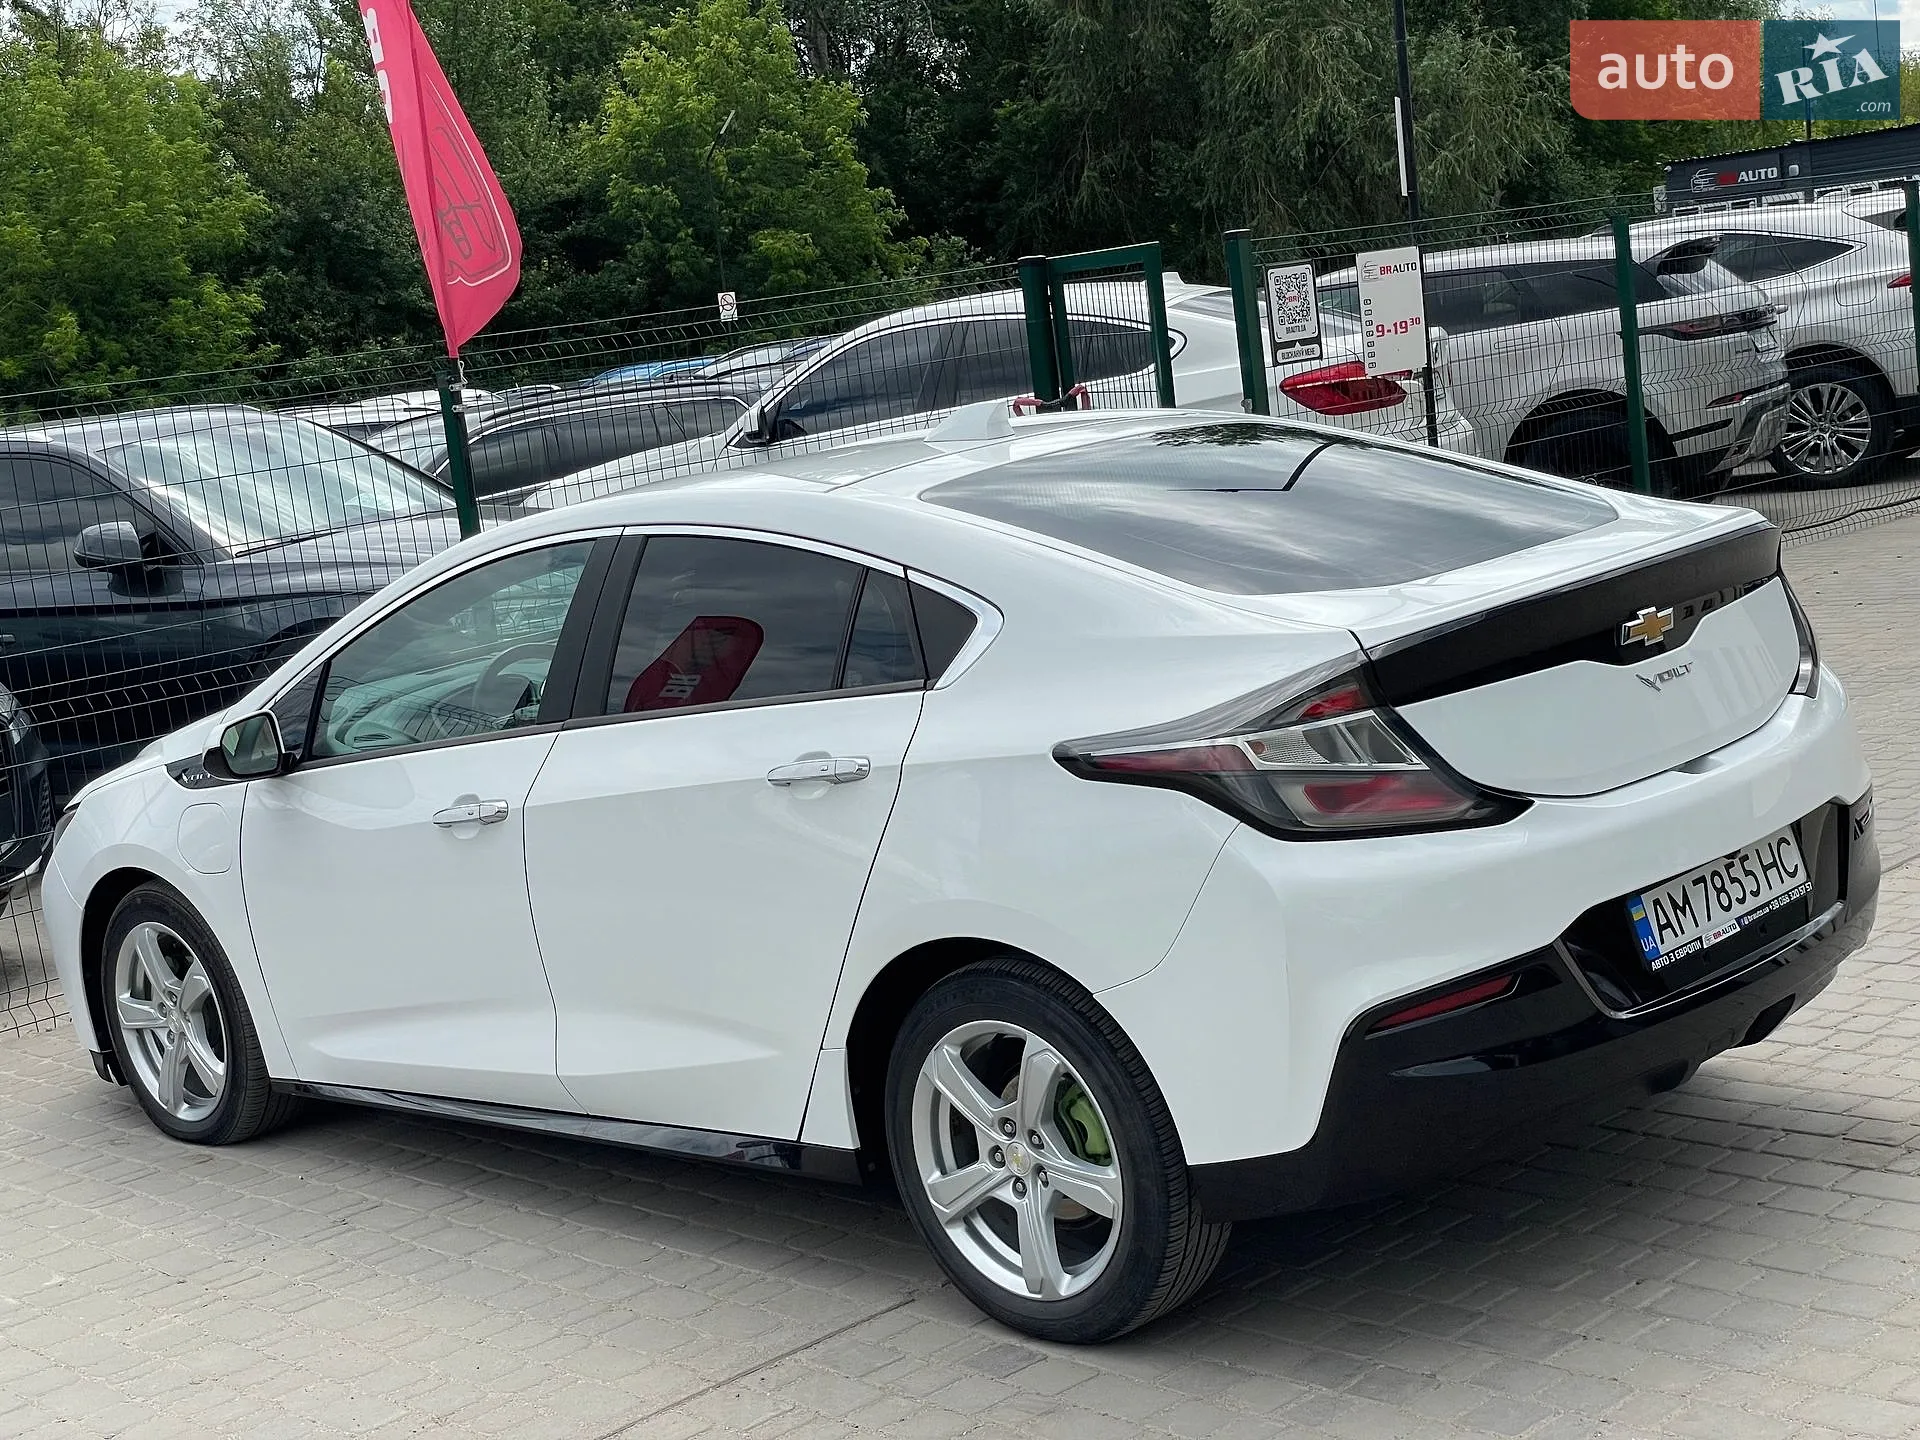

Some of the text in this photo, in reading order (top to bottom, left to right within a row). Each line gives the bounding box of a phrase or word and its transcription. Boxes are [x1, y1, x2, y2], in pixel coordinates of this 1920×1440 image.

[1379, 262, 1417, 276] BRAUTO
[1635, 661, 1693, 692] VOLT
[1712, 922, 1738, 940] BRAUTO
[1641, 934, 1657, 952] UA
[1651, 955, 1670, 971] АВТО
